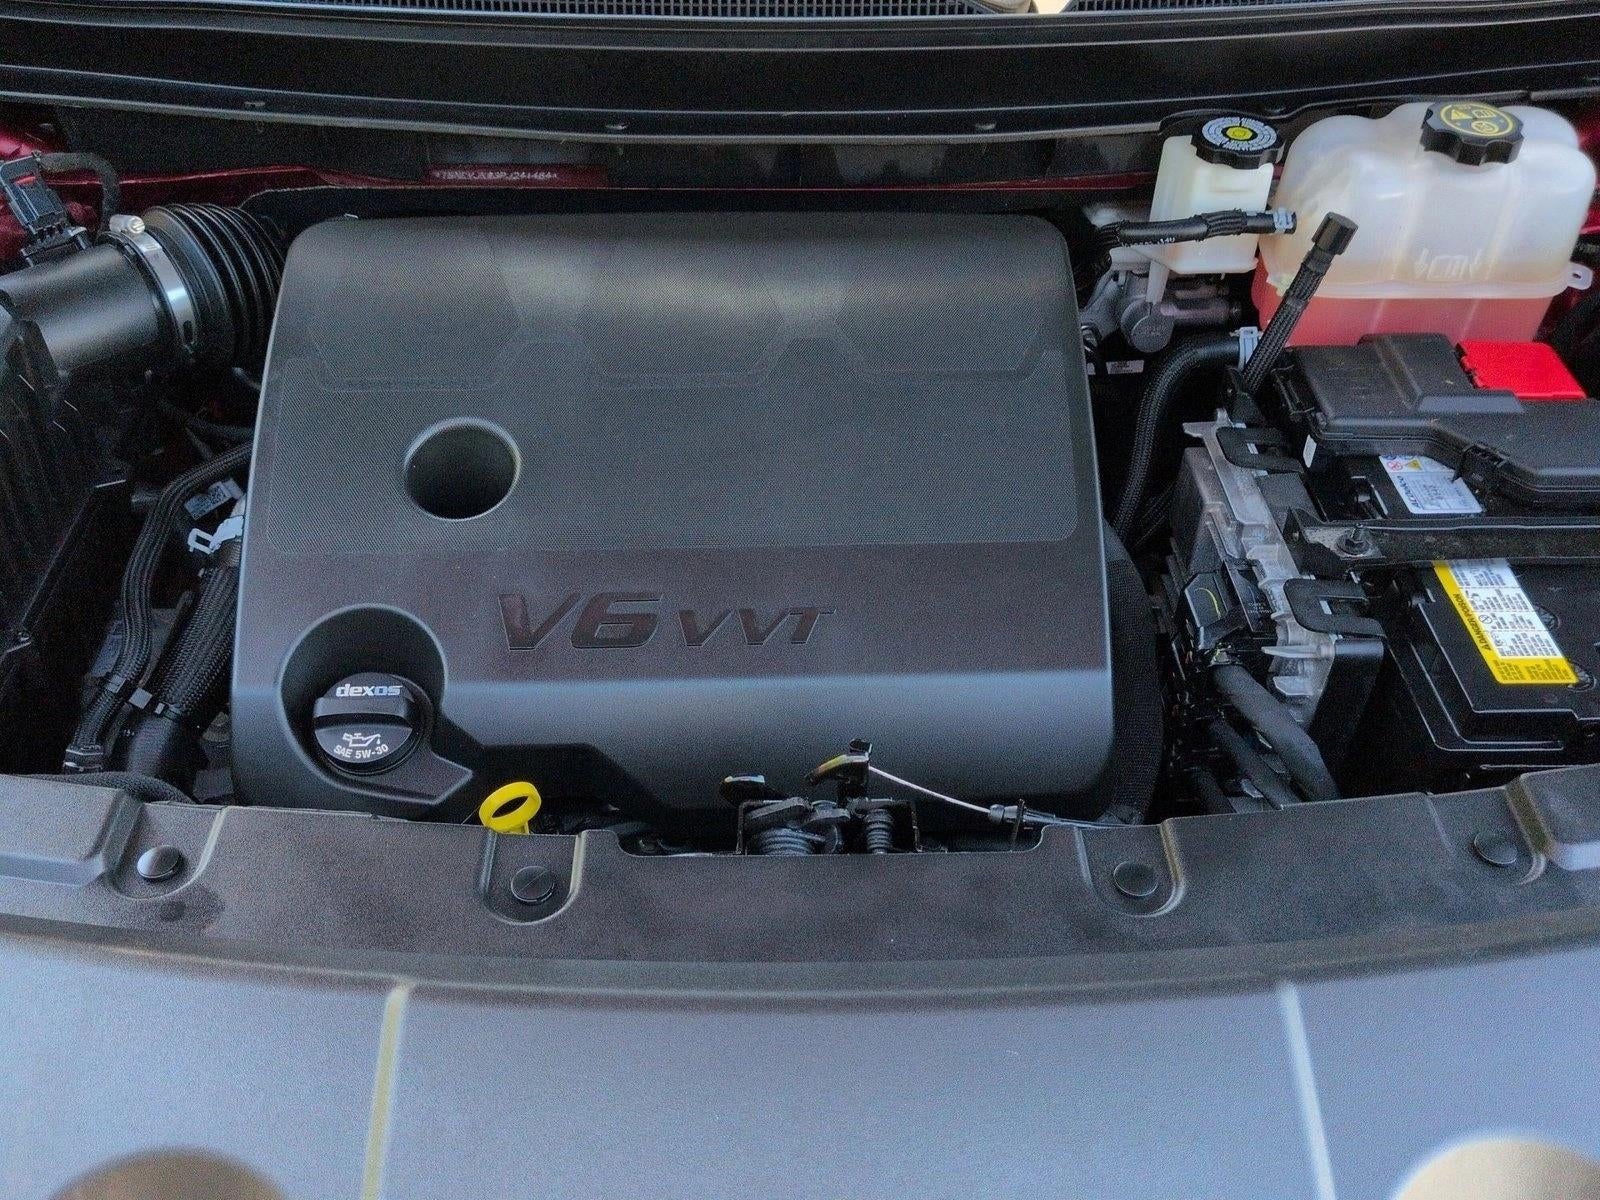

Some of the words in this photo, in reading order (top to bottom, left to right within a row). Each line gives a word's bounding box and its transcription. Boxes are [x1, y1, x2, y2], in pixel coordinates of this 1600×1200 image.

[498, 592, 663, 651] V6
[679, 607, 835, 647] VVT
[336, 683, 403, 697] dexos
[334, 745, 352, 758] SAE
[355, 744, 388, 759] 5W-30
